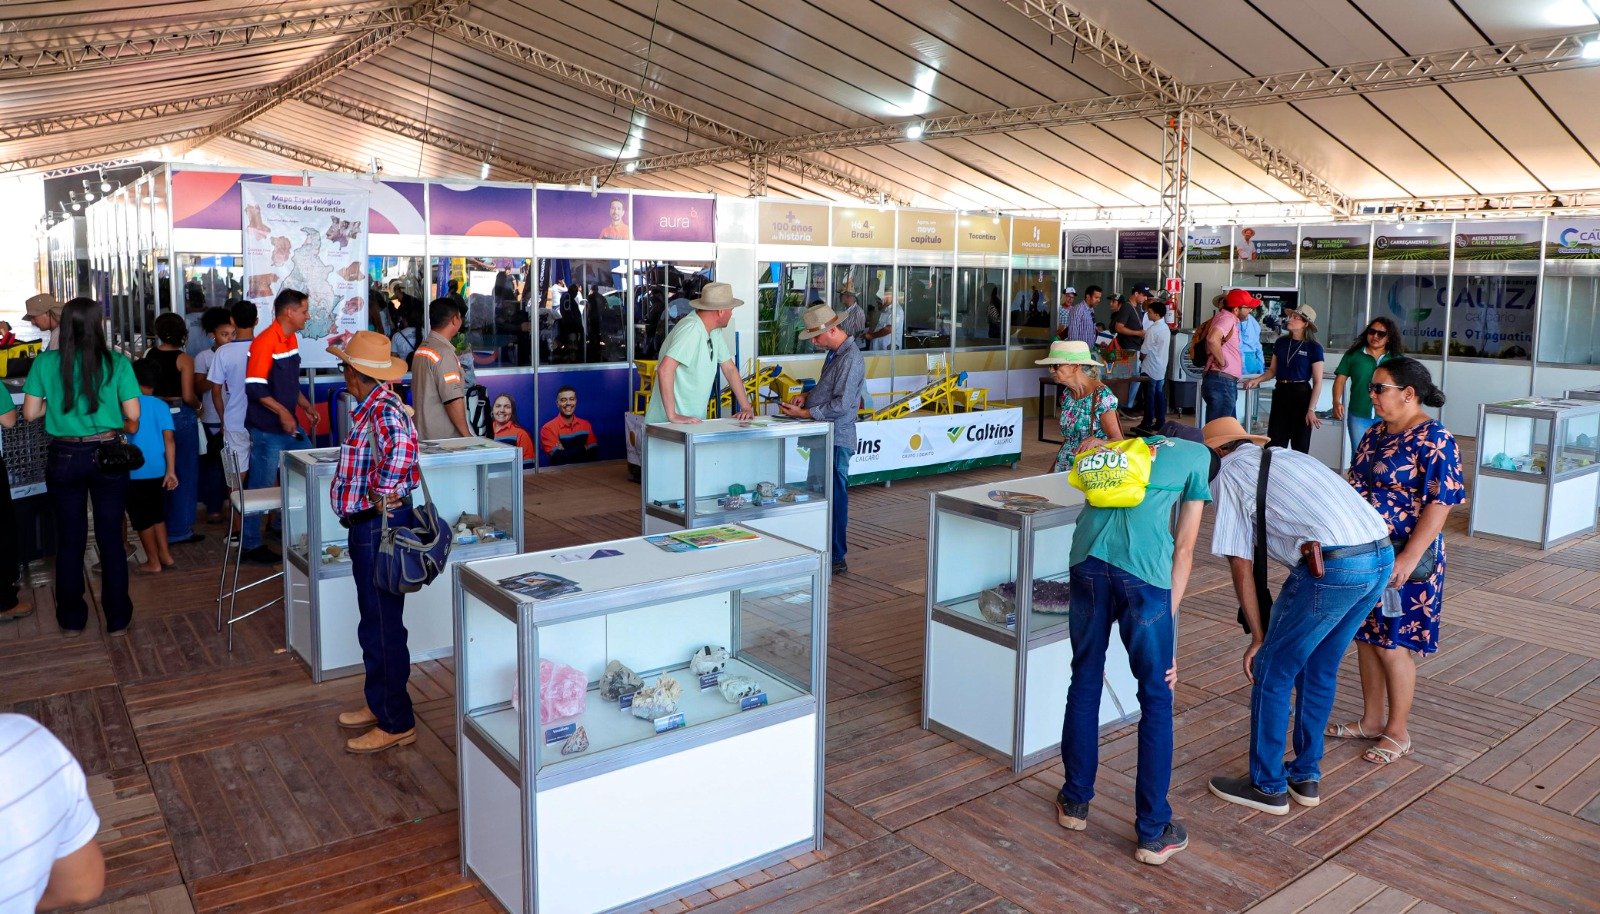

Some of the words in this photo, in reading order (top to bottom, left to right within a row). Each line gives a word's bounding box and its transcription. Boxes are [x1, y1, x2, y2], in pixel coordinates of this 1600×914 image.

[277, 203, 302, 211] Estado
[659, 216, 690, 228] aura
[772, 222, 789, 231] 100
[791, 224, 813, 232] anos
[910, 235, 942, 244] capítulo
[1194, 238, 1222, 246] CALIZA
[967, 418, 1015, 442] Caltins
